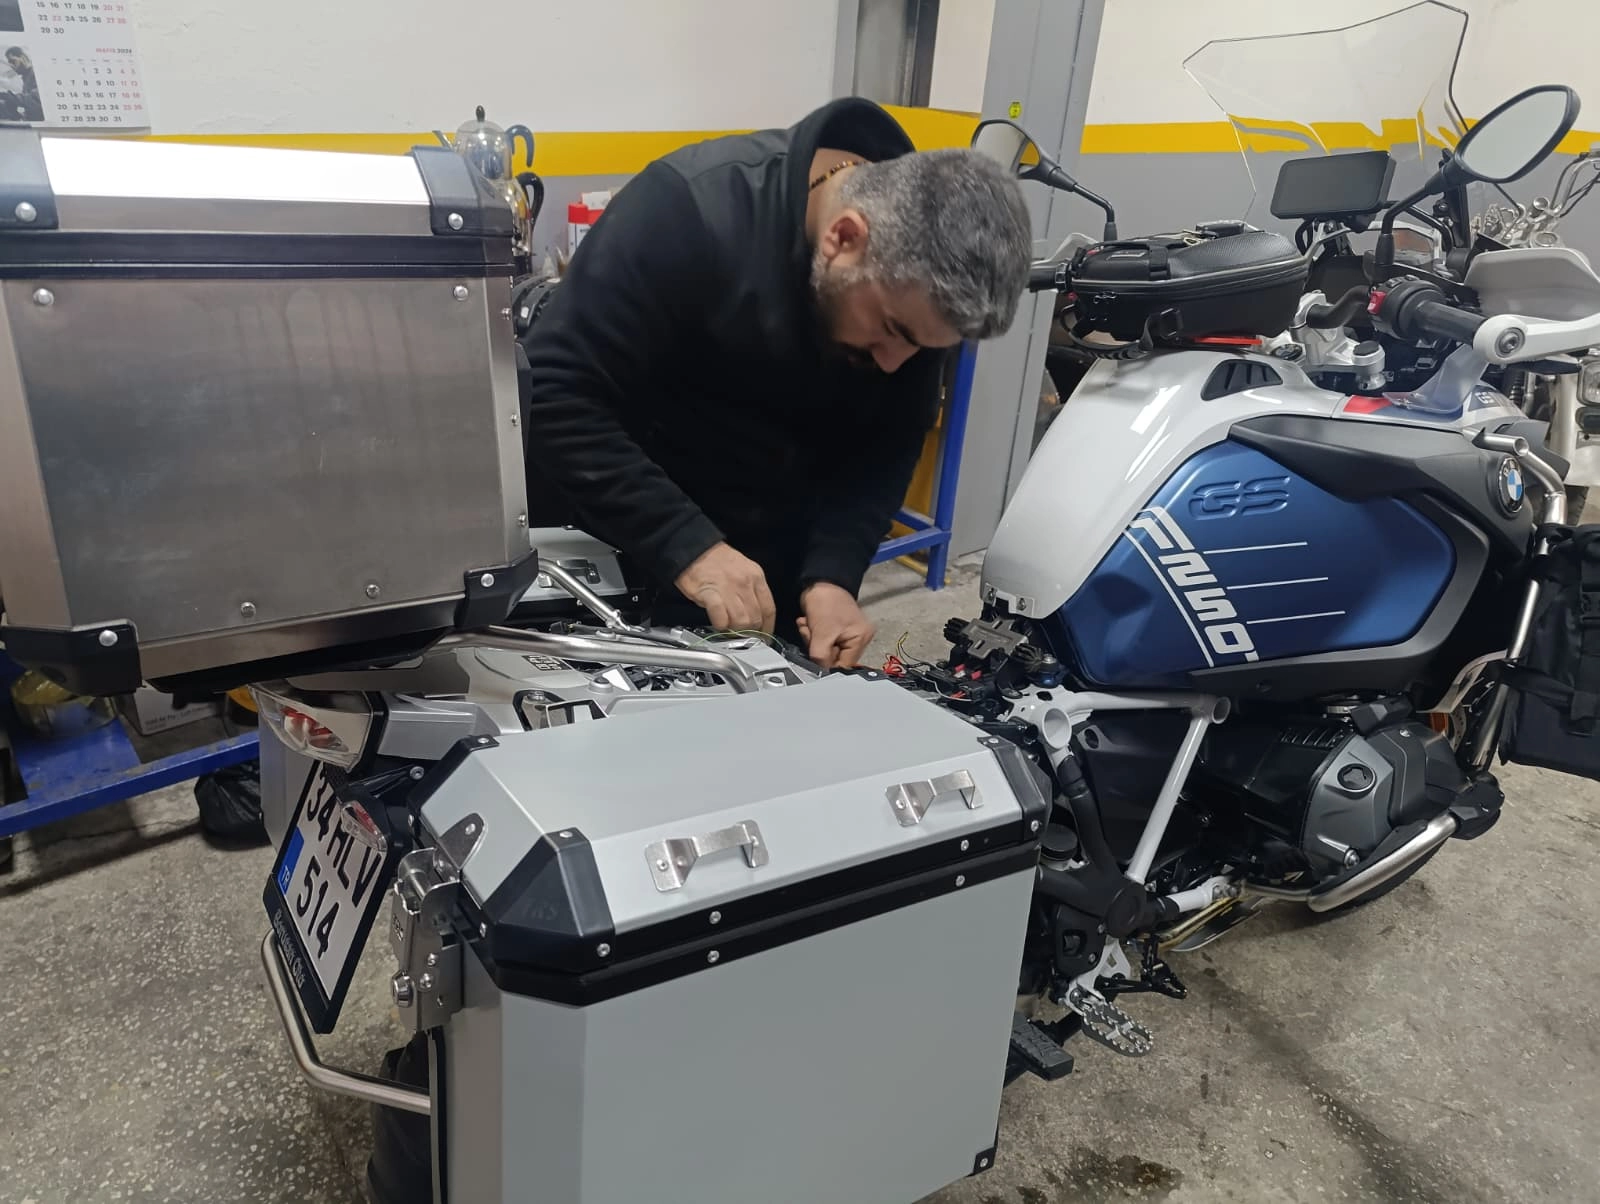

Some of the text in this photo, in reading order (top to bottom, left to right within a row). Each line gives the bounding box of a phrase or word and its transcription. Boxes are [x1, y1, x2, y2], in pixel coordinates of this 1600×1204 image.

[1187, 475, 1291, 521] GS
[306, 763, 337, 842] 34
[296, 855, 340, 960] 514
